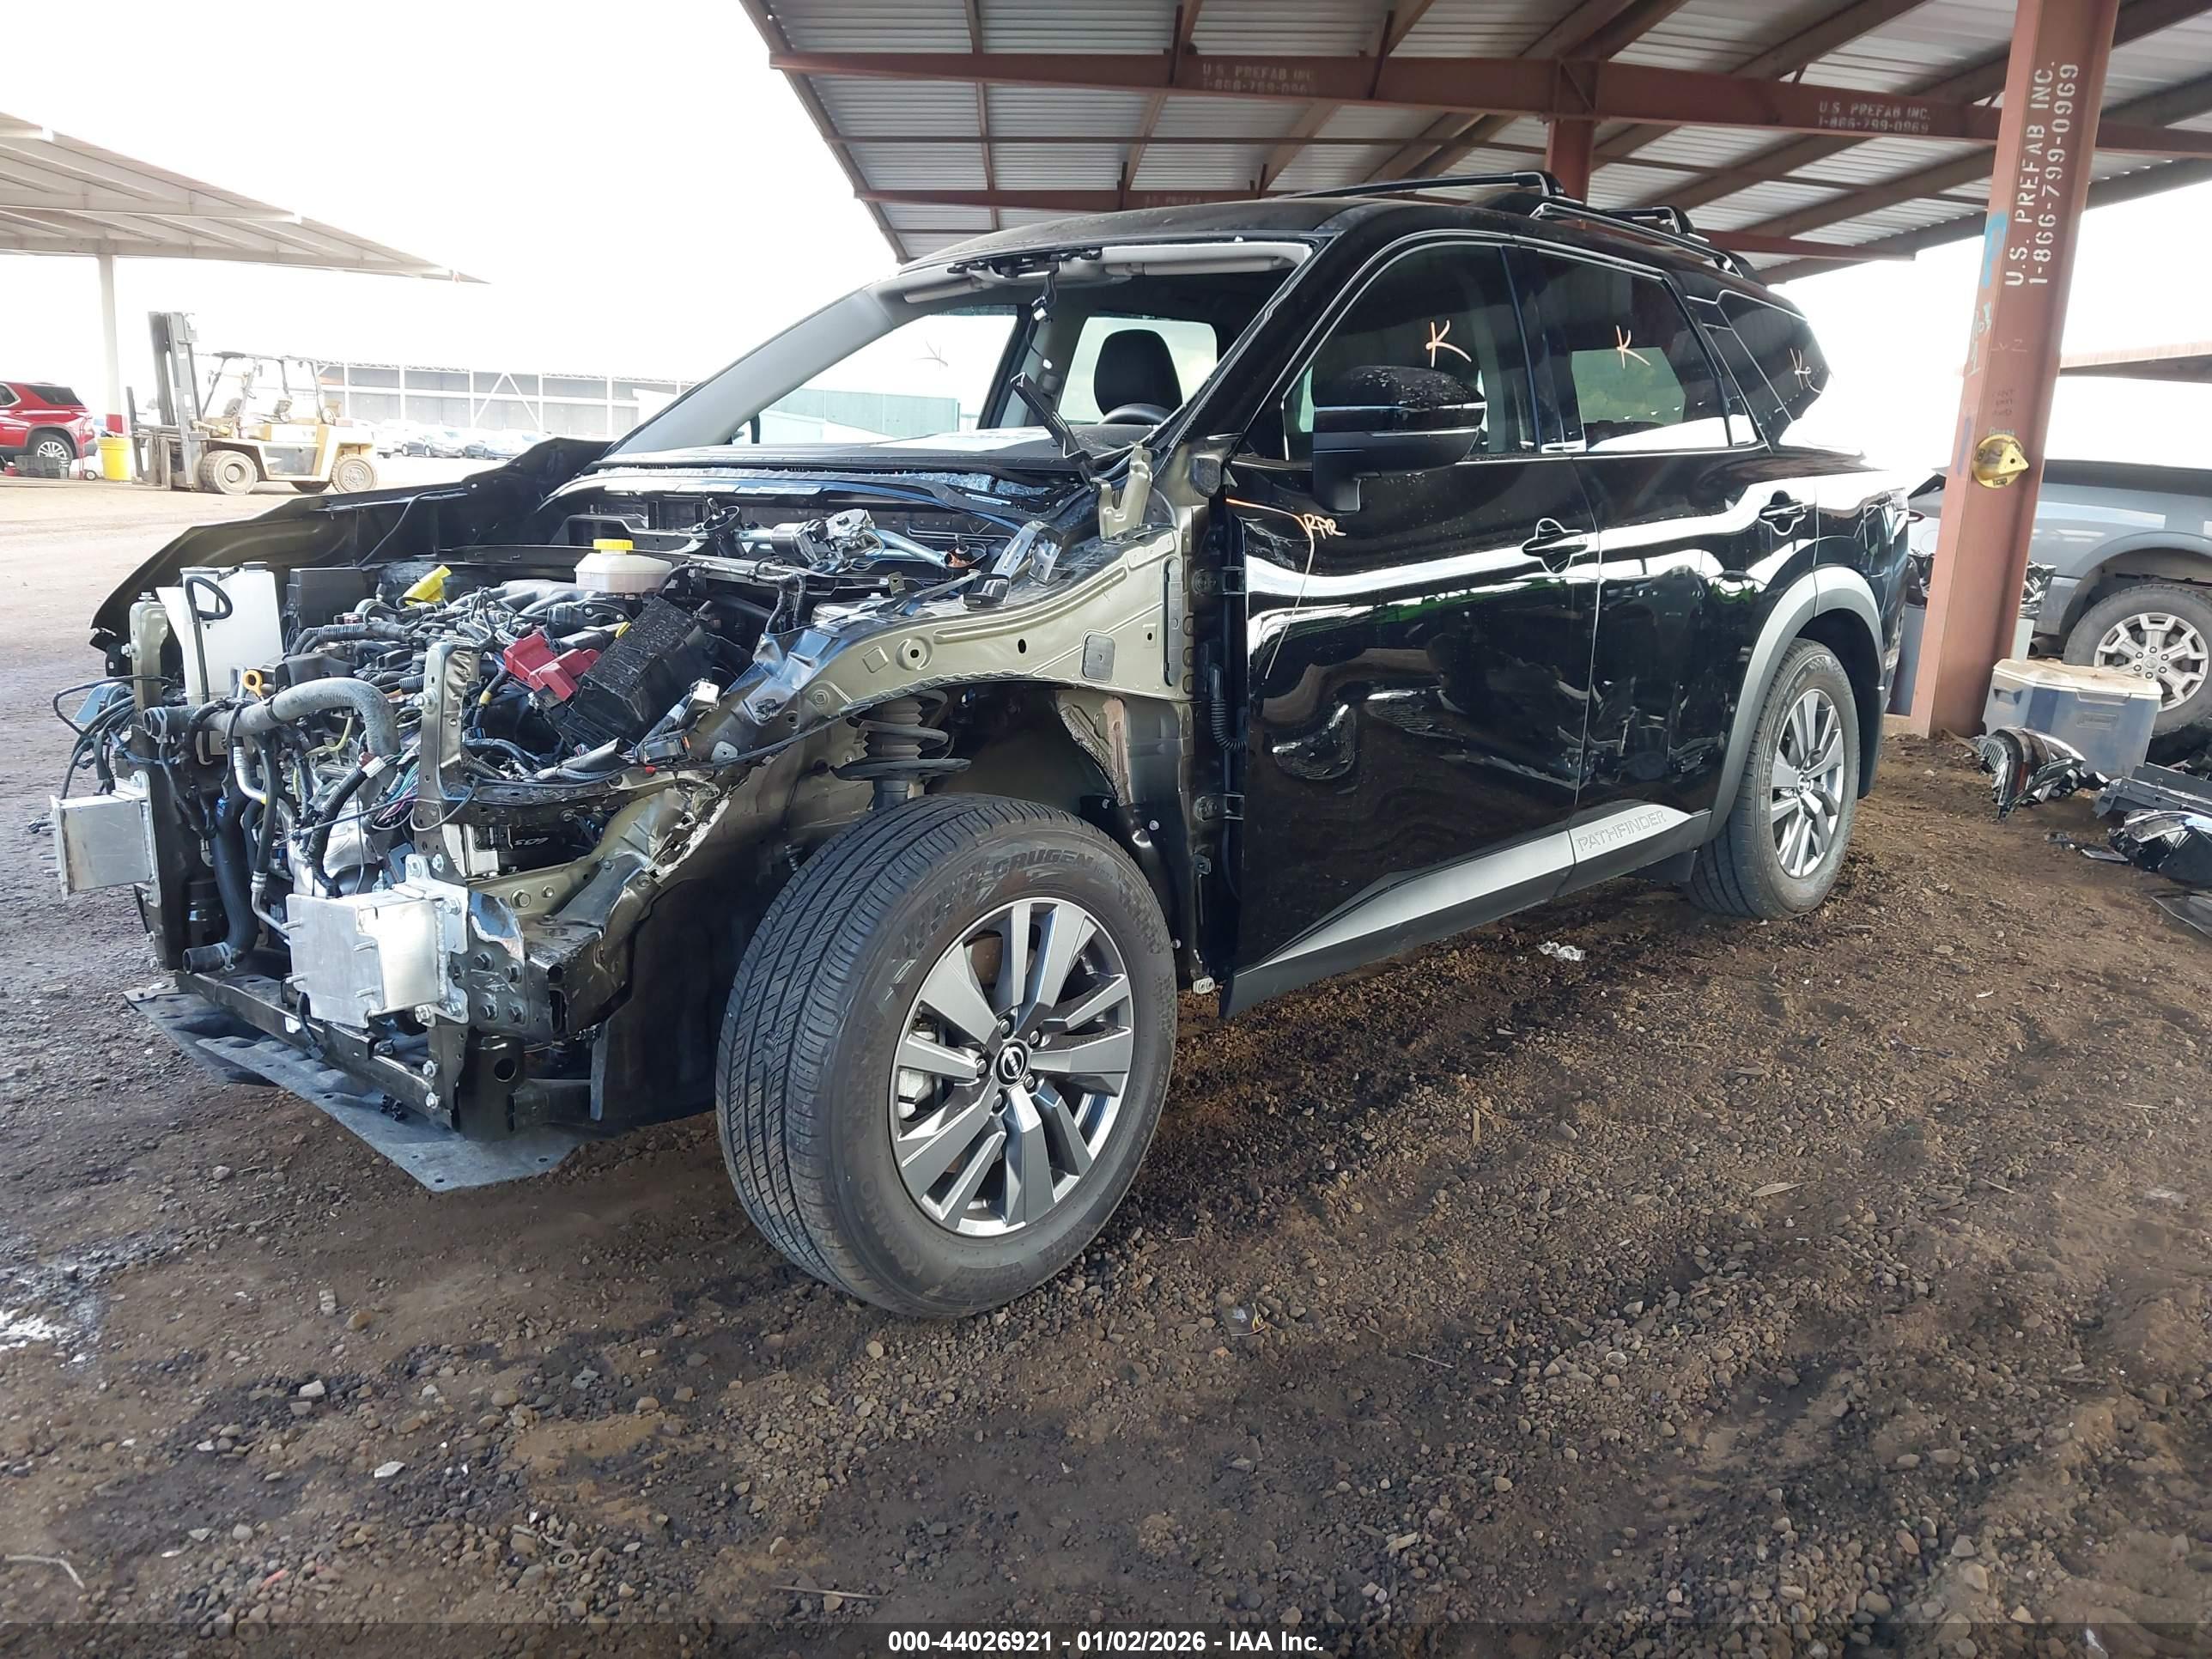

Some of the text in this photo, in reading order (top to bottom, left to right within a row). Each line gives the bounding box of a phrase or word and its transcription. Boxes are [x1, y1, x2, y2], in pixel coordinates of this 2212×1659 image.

[1850, 102, 1902, 118] PREFAB
[1906, 105, 1931, 121] INC.
[2005, 61, 2055, 286] U.S. PREFAB INC.
[2028, 64, 2080, 285] 1-866-799-0969
[1425, 319, 1472, 368] K
[1615, 324, 1651, 369] K
[1576, 810, 1668, 852] PATHFINDER
[993, 848, 1095, 875] CRUGEN
